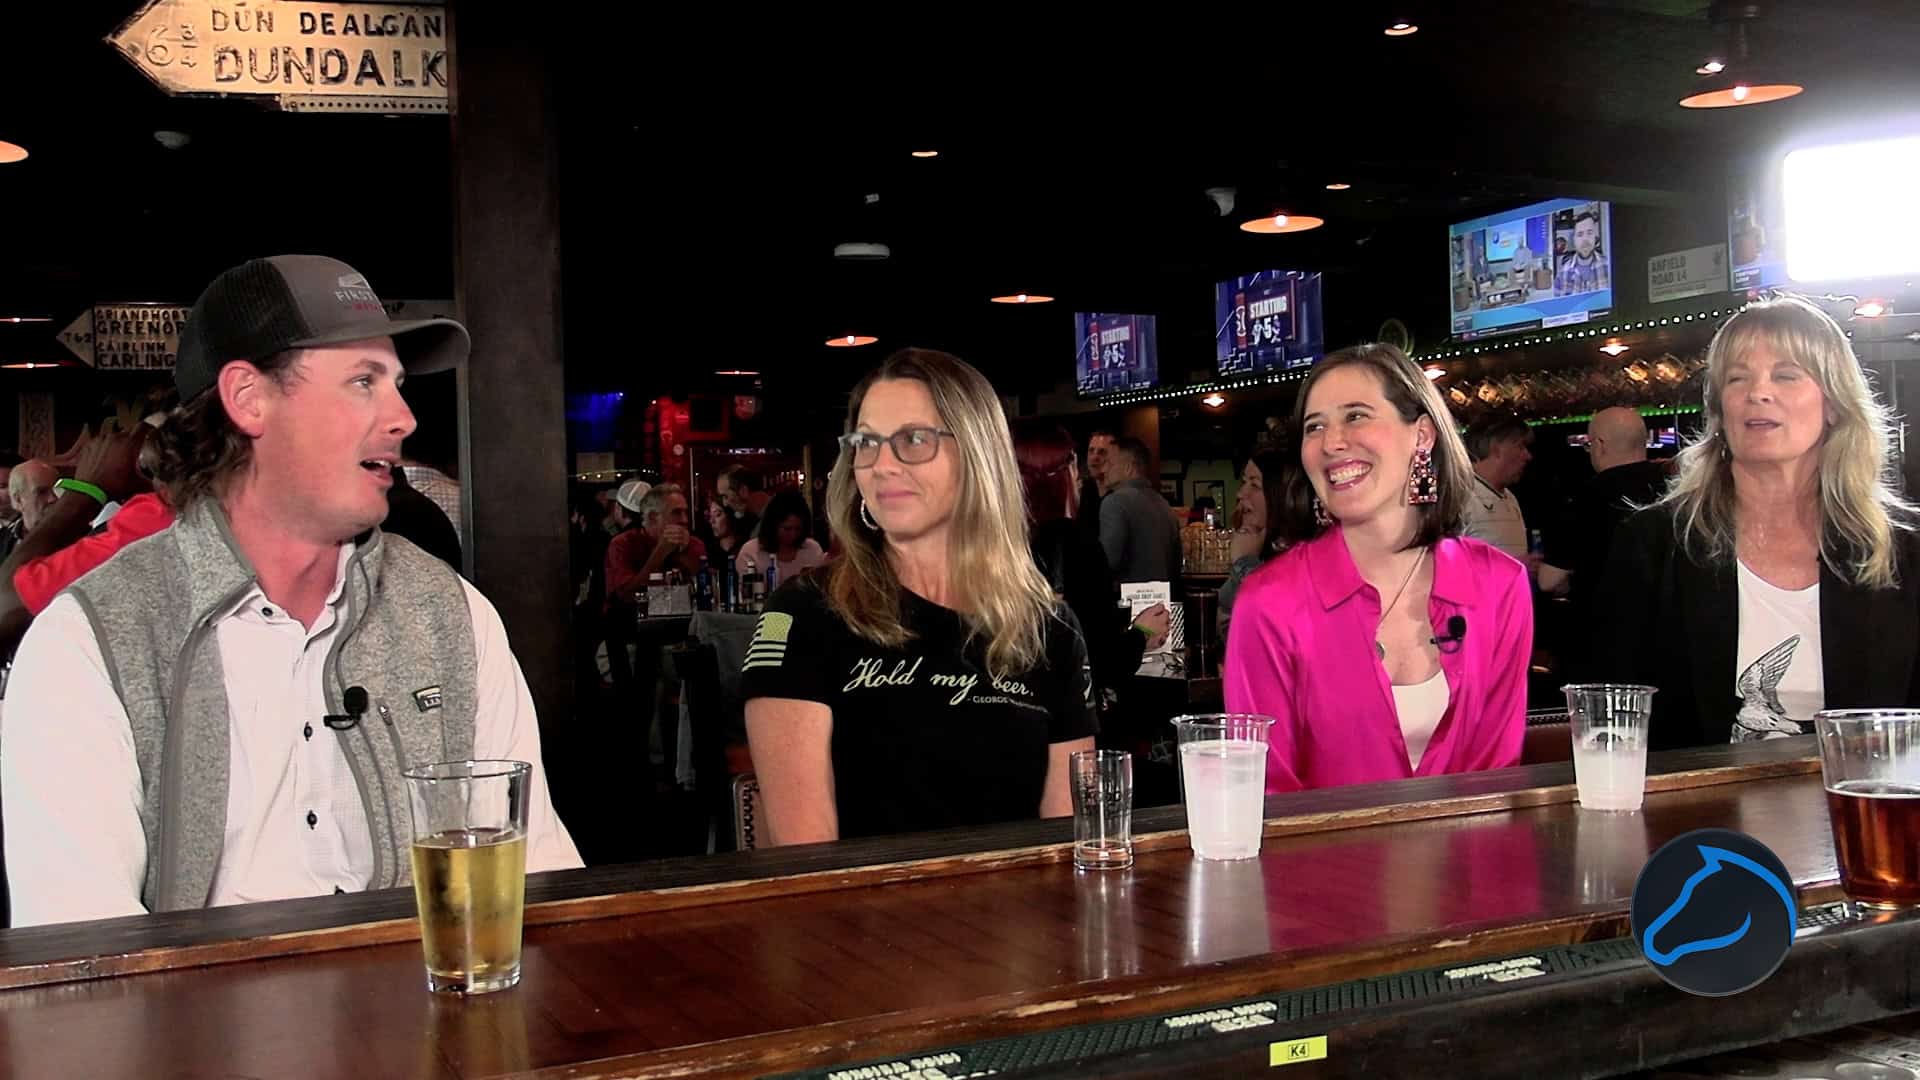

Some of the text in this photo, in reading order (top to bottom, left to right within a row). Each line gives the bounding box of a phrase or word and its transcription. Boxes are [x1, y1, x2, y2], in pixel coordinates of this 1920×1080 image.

[214, 45, 447, 87] DUNDALK
[97, 320, 185, 336] GREENOR
[98, 352, 177, 368] CARLING
[843, 656, 924, 692] Hold
[930, 673, 979, 705] my
